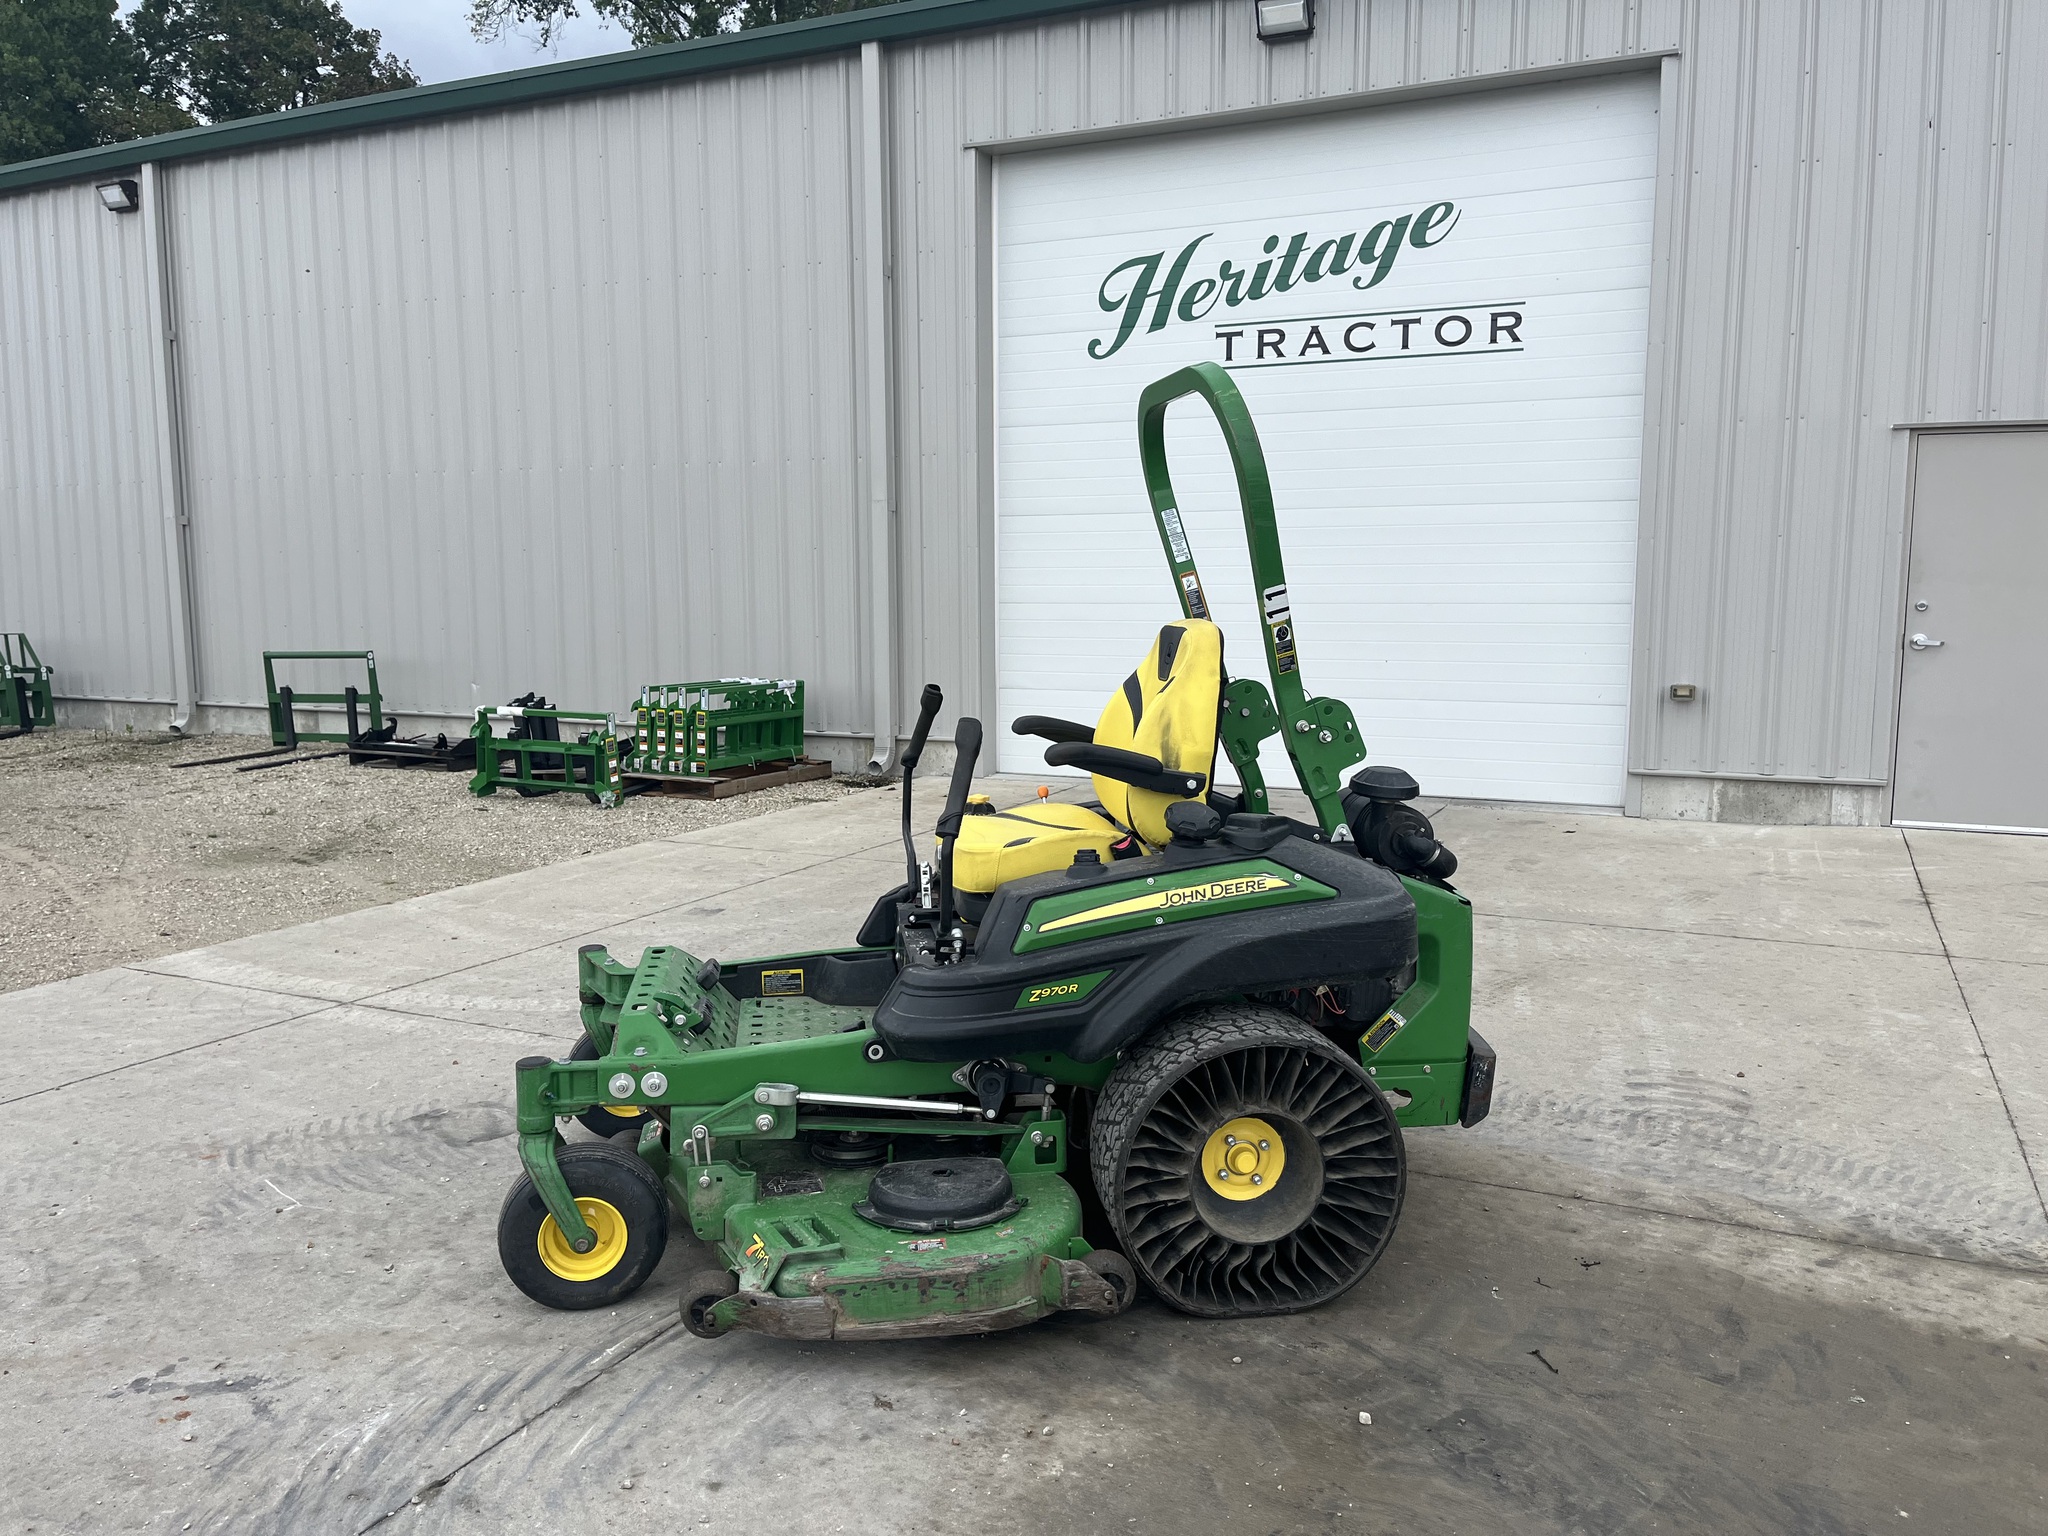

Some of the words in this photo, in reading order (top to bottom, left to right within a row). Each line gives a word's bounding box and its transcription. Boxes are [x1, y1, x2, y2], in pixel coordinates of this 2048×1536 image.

[1088, 201, 1462, 360] Heritage
[1215, 311, 1524, 362] TRACTOR
[1159, 887, 1207, 907] JOHN
[1210, 878, 1267, 898] DEERE
[1028, 983, 1080, 1002] Z970R
